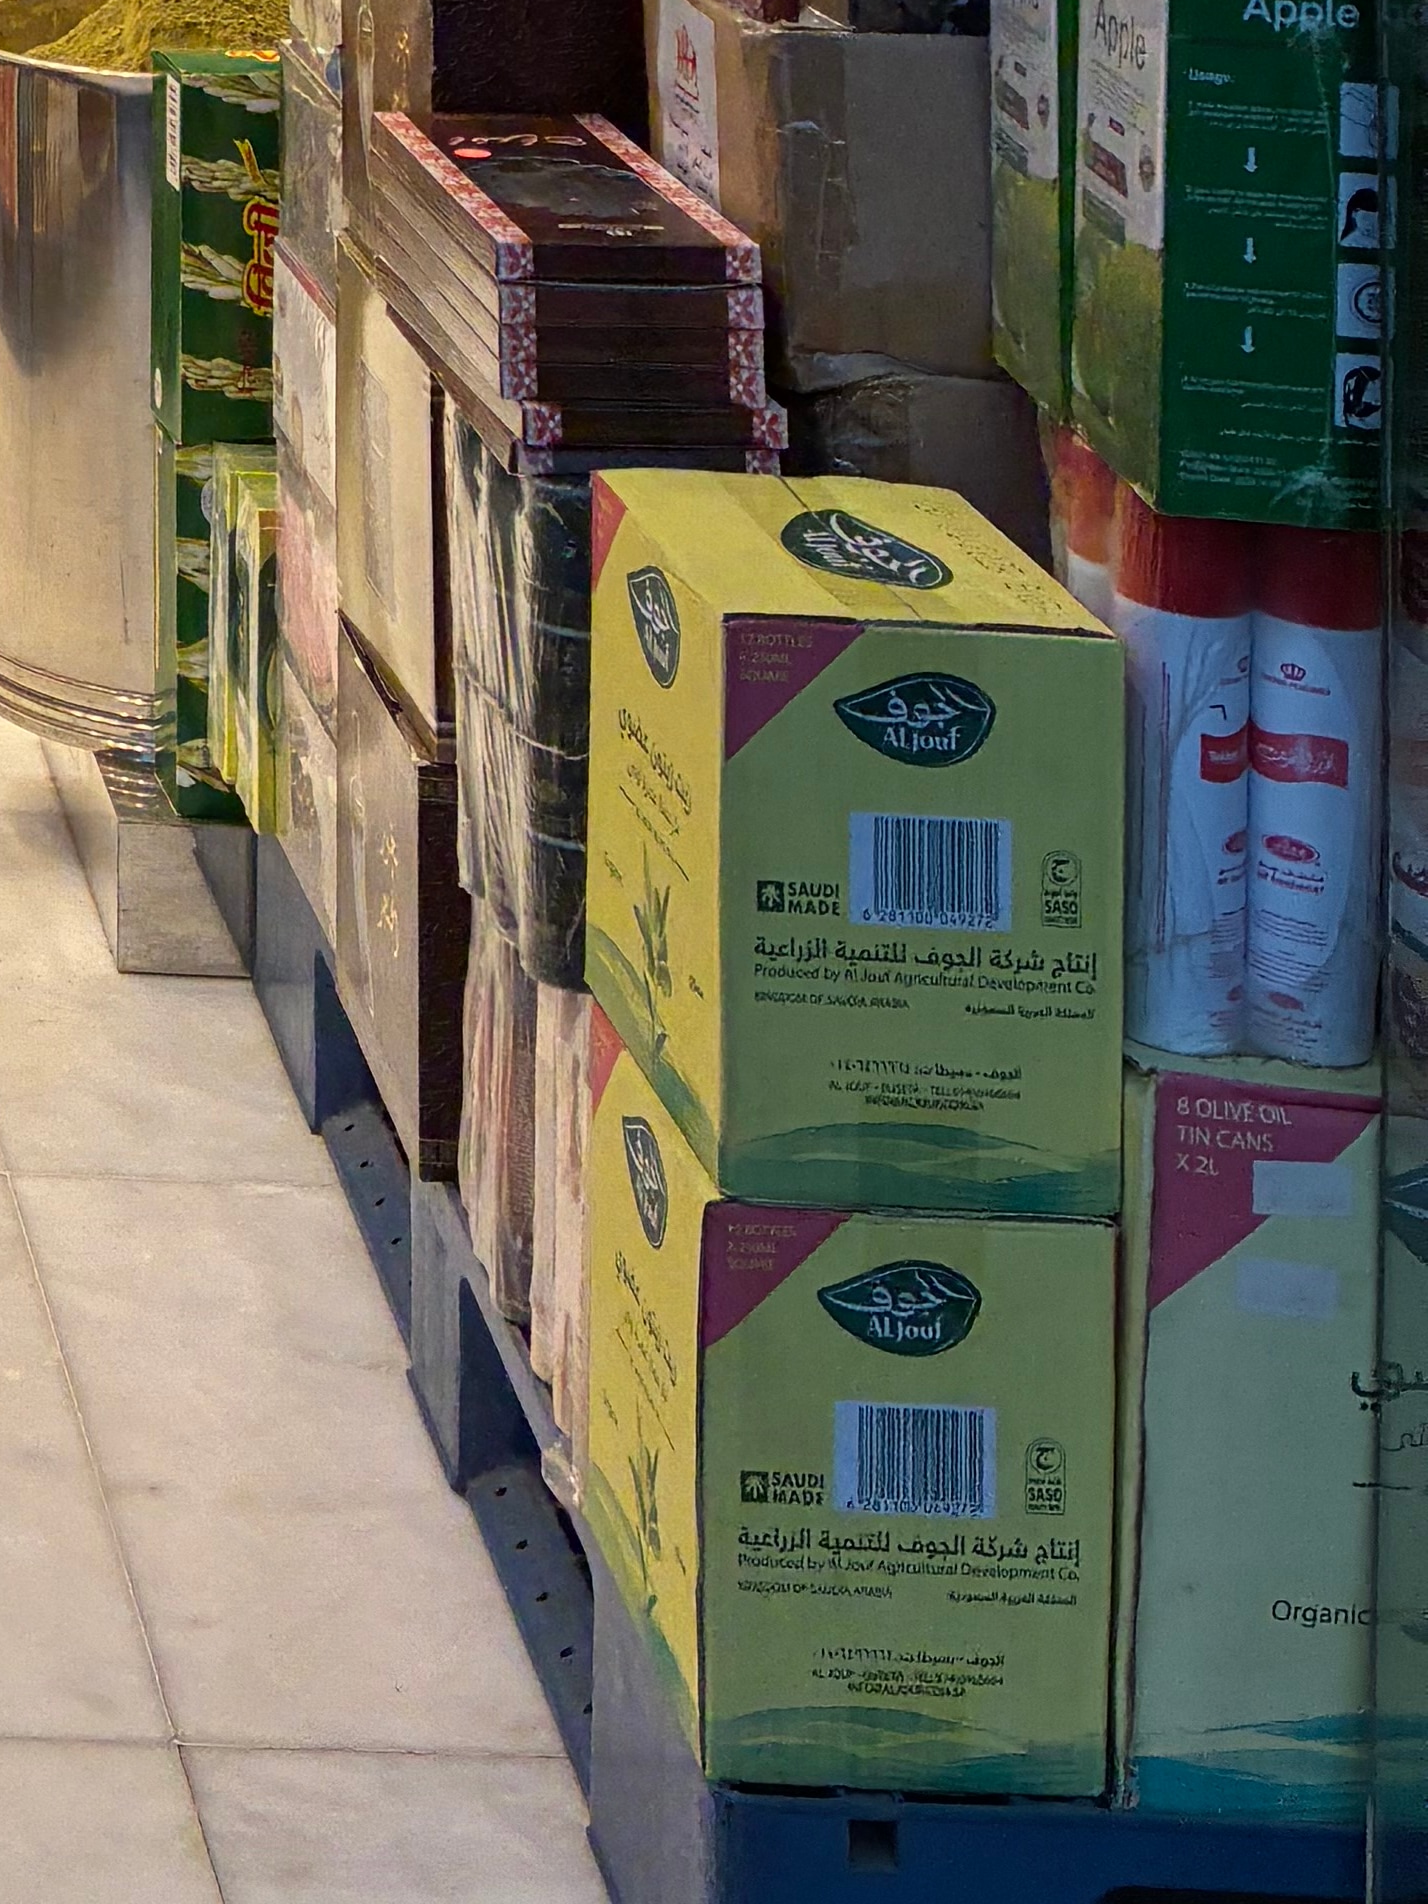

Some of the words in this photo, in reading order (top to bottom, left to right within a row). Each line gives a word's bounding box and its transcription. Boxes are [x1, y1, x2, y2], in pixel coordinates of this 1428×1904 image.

[788, 882, 839, 897] SAUDI
[788, 899, 840, 915] MADE
[1045, 899, 1077, 914] SASO
[754, 936, 827, 960] الزراعية
[835, 940, 906, 964] للتنمية
[914, 947, 981, 969] الجوف
[990, 950, 1044, 970] شركة
[1052, 953, 1097, 979] إنتاج
[754, 964, 819, 979] Produced
[823, 968, 840, 983] by
[978, 974, 1071, 995] Development
[1177, 1098, 1189, 1116] 8
[1196, 1099, 1254, 1123] OLIVE
[1259, 1103, 1293, 1127] OIL
[1177, 1124, 1210, 1148] TIN
[1216, 1128, 1274, 1153] CANS
[772, 1473, 824, 1489] SAUDI
[771, 1490, 824, 1506] MADE
[738, 1527, 811, 1549] الزراعية
[818, 1530, 889, 1553] للتنمية
[898, 1535, 964, 1558] الجوف
[972, 1535, 1027, 1559] شركة
[738, 1554, 803, 1570] Produced
[806, 1557, 824, 1571] by
[1035, 1539, 1079, 1566] إنتاج
[1271, 1599, 1372, 1630] Organic
